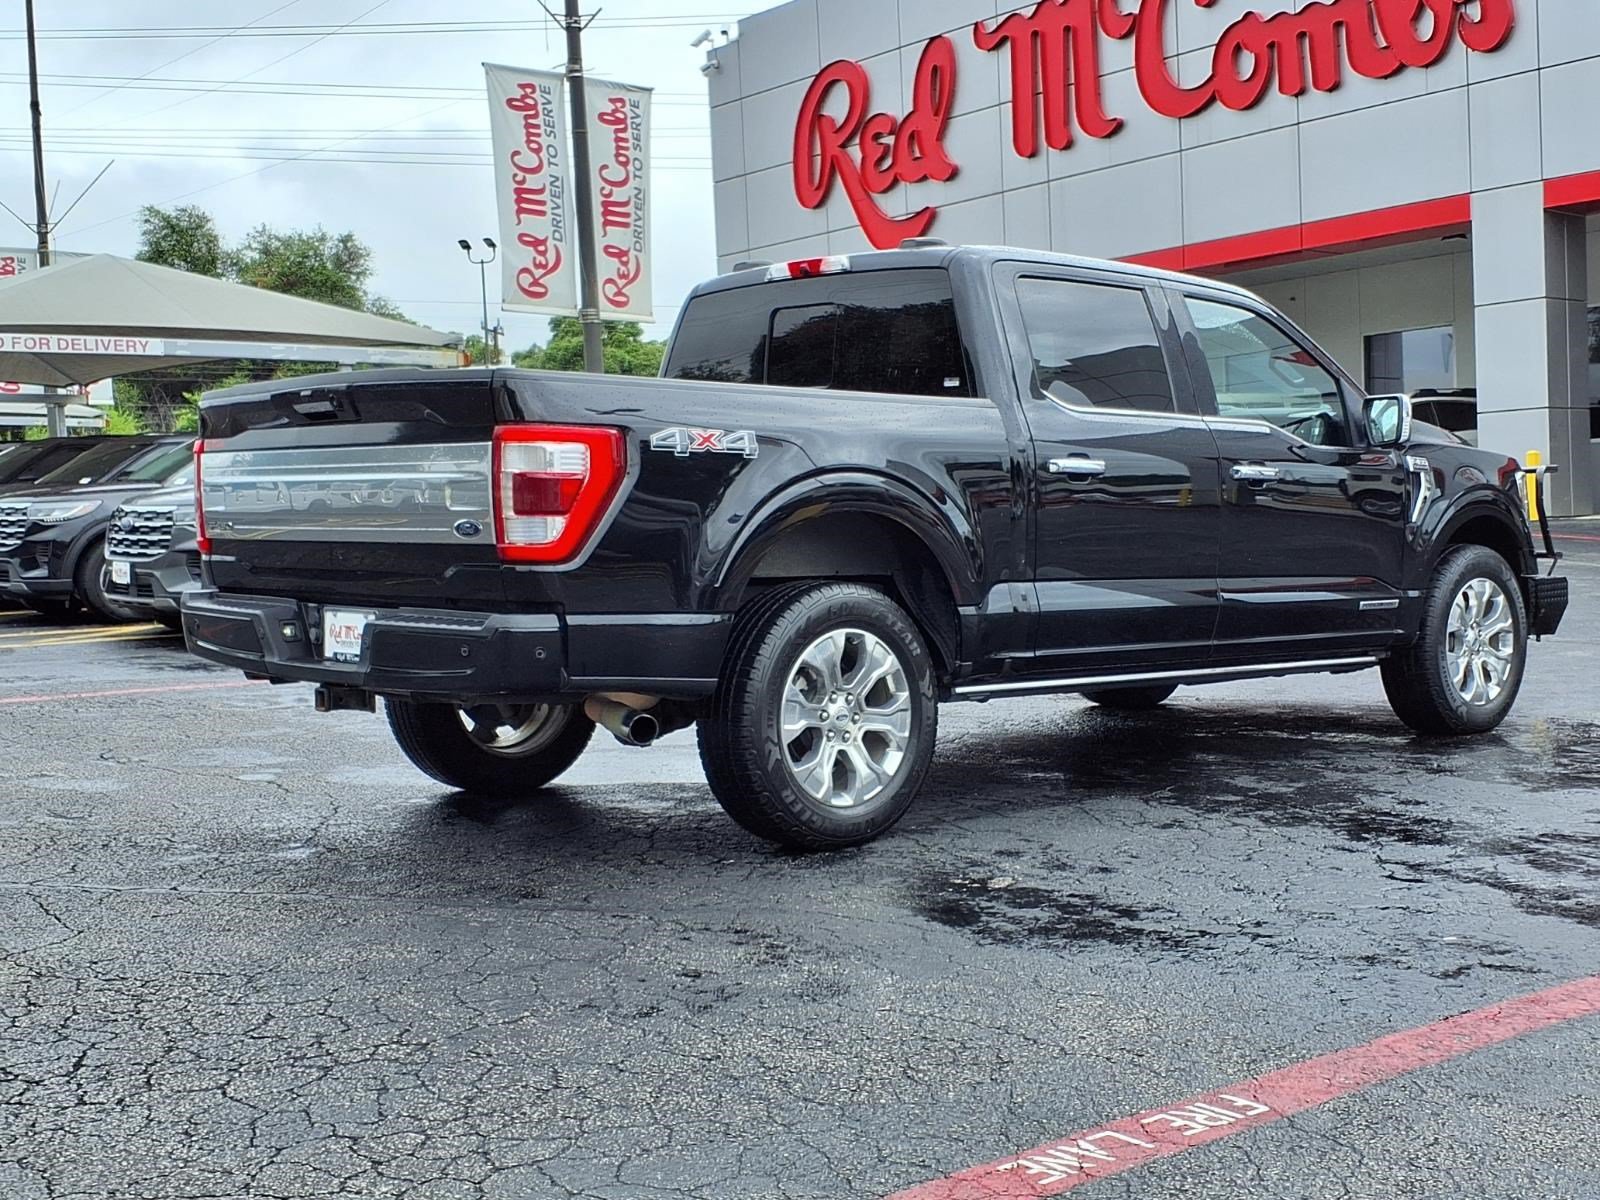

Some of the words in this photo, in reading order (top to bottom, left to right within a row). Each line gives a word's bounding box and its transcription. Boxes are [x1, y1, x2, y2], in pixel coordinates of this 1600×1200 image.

[539, 83, 557, 140] SERVE
[628, 97, 643, 151] SERVE
[505, 82, 548, 226] McCombs
[547, 143, 559, 169] TO
[597, 96, 632, 238] McCombs
[632, 157, 643, 180] TO
[793, 35, 960, 250] Red
[549, 174, 564, 244] DRIVEN
[631, 187, 643, 254] DRIVEN
[515, 232, 562, 300] Red
[602, 244, 641, 309] Red
[11, 336, 51, 351] FOR
[57, 337, 150, 353] DELIVERY
[1140, 1093, 1270, 1137] FIRE
[995, 1129, 1156, 1186] LANE
